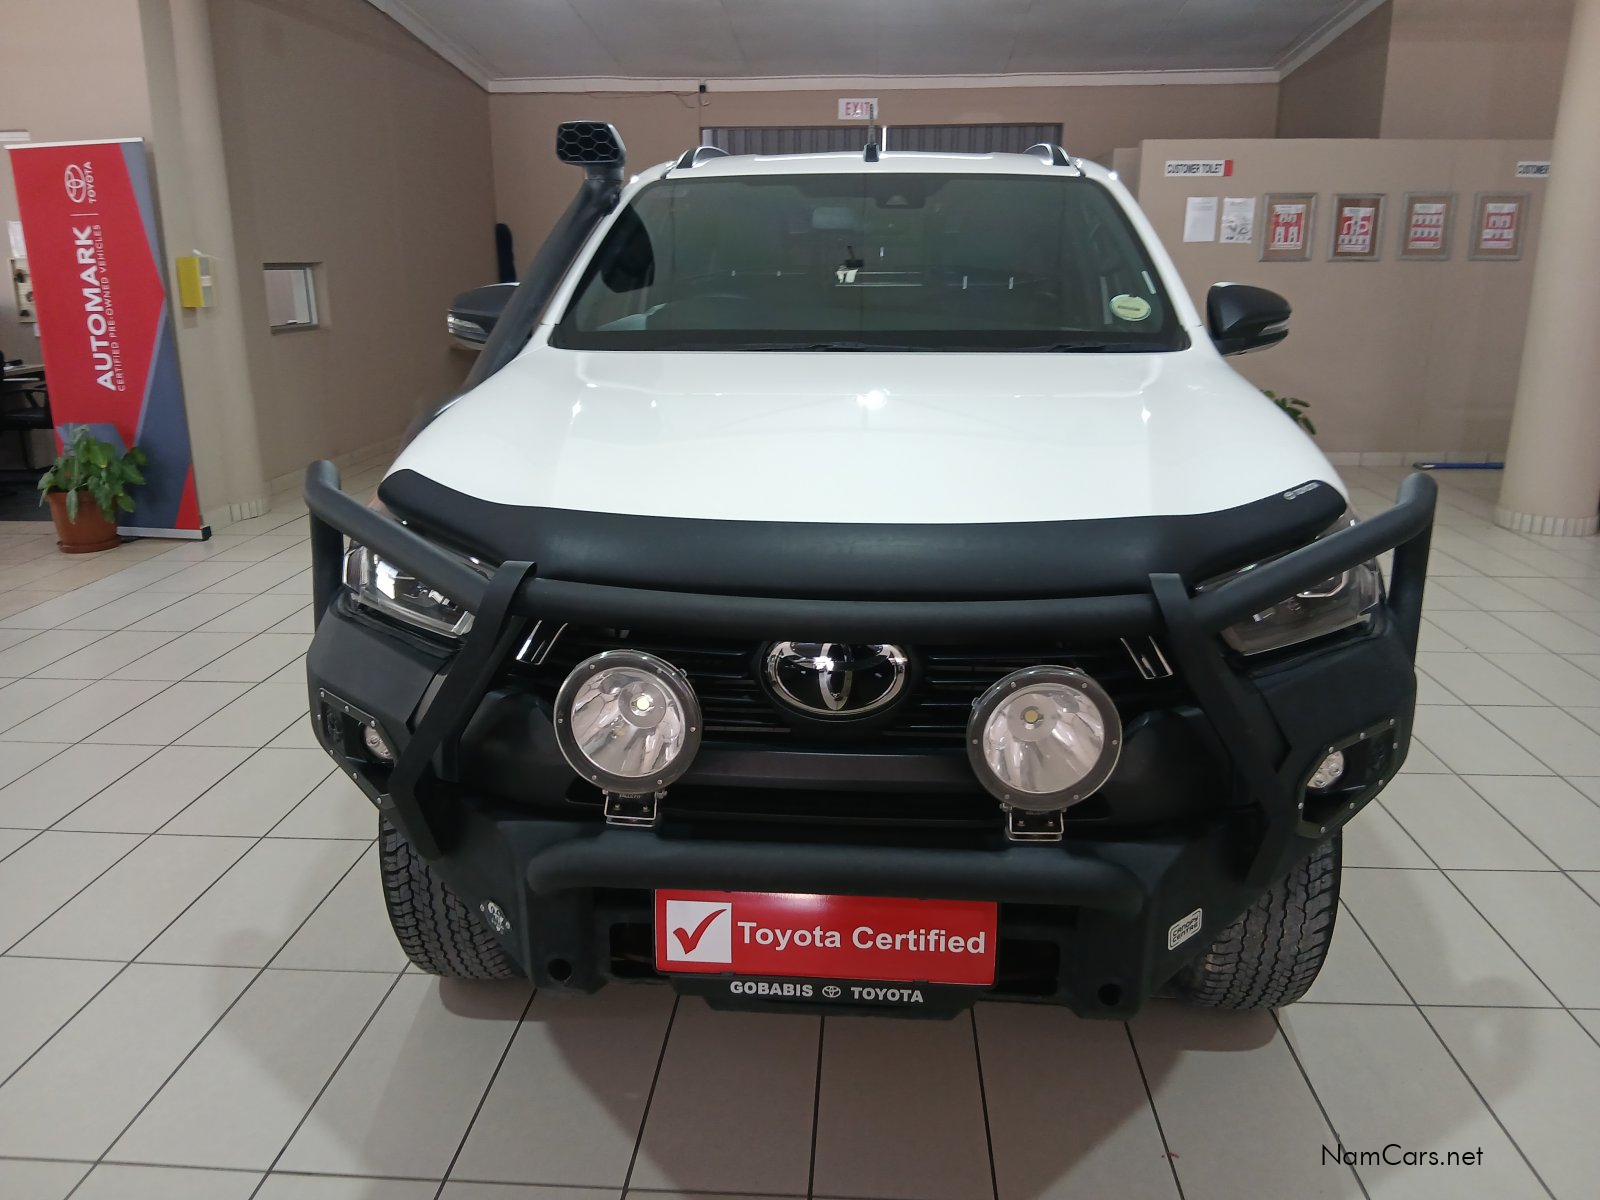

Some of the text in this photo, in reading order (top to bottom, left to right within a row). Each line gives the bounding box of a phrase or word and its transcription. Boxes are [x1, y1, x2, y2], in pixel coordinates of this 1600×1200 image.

[845, 102, 871, 116] EXIT
[83, 161, 97, 204] TOYOTA
[1167, 163, 1223, 174] CUSTOMER TOILET
[92, 224, 107, 273] VEHICLES
[71, 225, 116, 391] AUTOMARK
[110, 341, 126, 392] CERTIFIED
[737, 921, 986, 954] Toyota Certified
[729, 980, 924, 1004] GOBABIS TOYOTA
